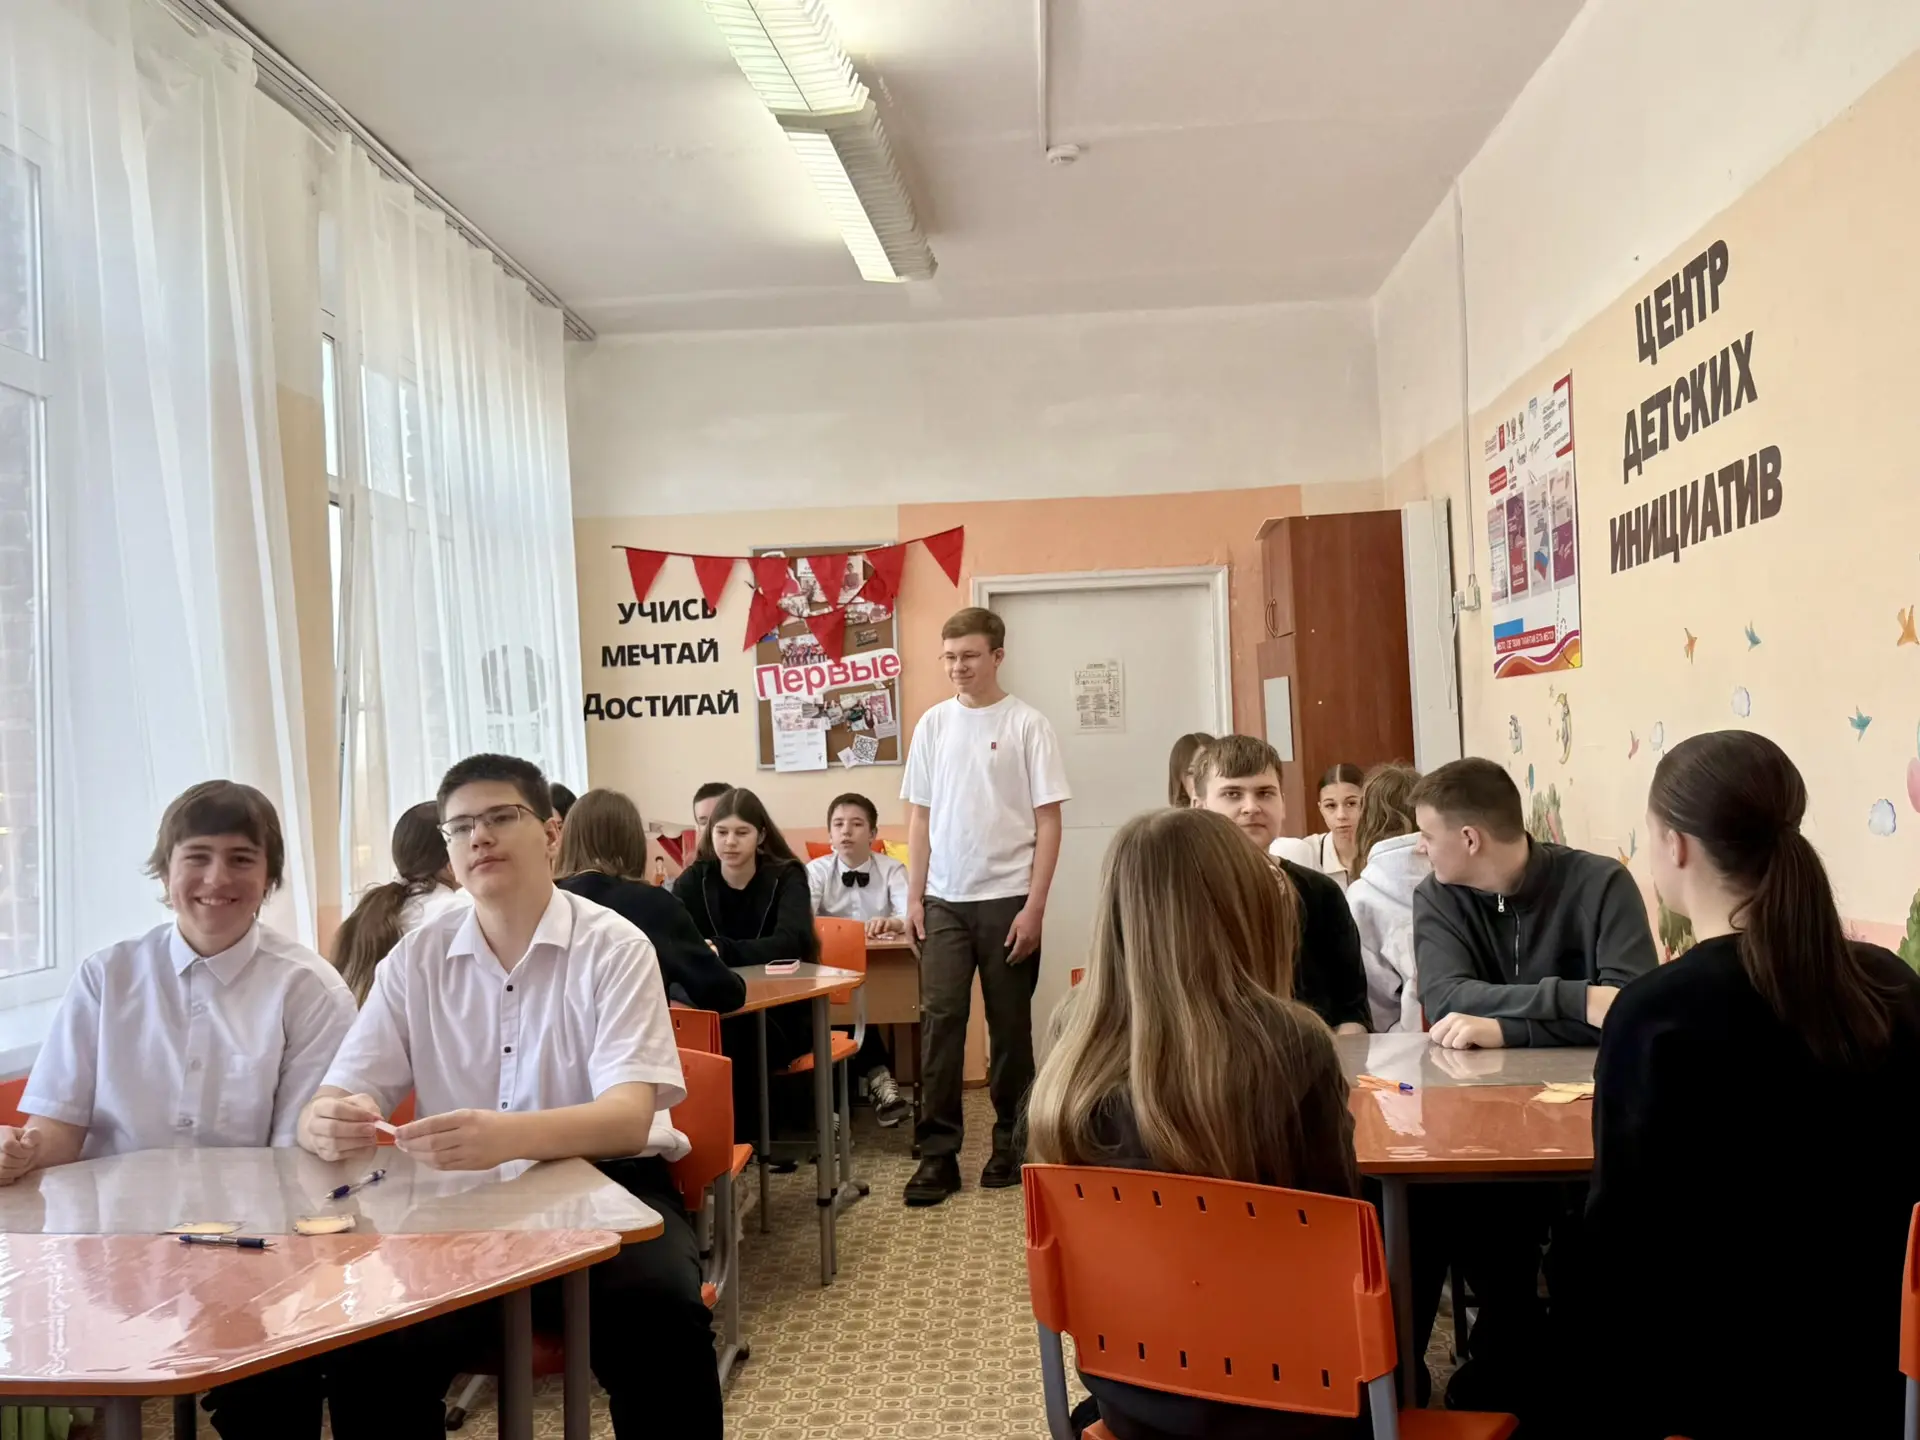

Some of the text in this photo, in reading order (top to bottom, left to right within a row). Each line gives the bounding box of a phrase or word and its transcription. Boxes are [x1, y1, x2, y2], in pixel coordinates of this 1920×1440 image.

[1635, 239, 1729, 365] ЦЕНТР
[1623, 330, 1758, 485] ДЕТСКИХ
[1609, 444, 1783, 575] ИНИЦИАТИВ
[617, 597, 717, 625] УЧИСЬ
[601, 638, 720, 668] МЕЧТАЙ
[757, 653, 902, 700] Первые
[583, 689, 740, 723] ДОСТИГАЙ
